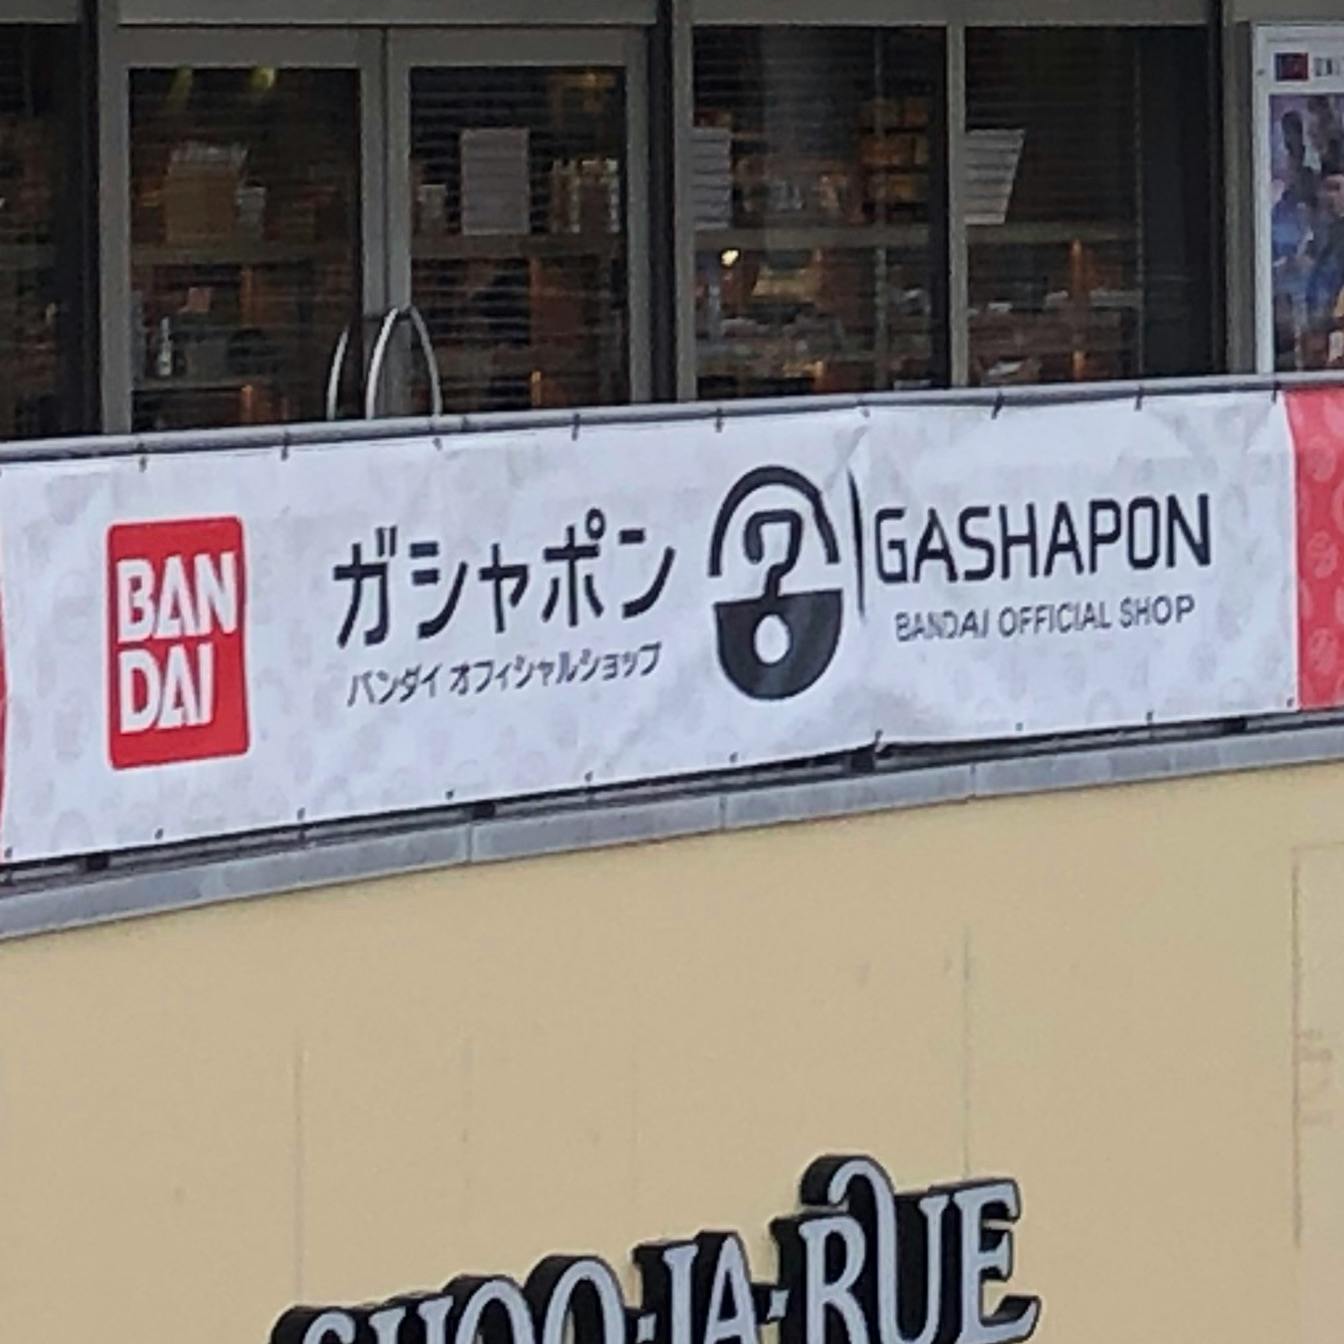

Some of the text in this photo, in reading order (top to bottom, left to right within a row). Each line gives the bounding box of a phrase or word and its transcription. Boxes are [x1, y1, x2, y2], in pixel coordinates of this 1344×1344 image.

[332, 508, 676, 649] ガシャポン
[874, 493, 1212, 584] GASHAPON
[117, 551, 238, 644] BAN
[894, 593, 1196, 643] BANDAI OFFICIAL SHOP
[118, 641, 214, 734] DAI
[347, 641, 662, 707] バンダイ オフィシャルショップ
